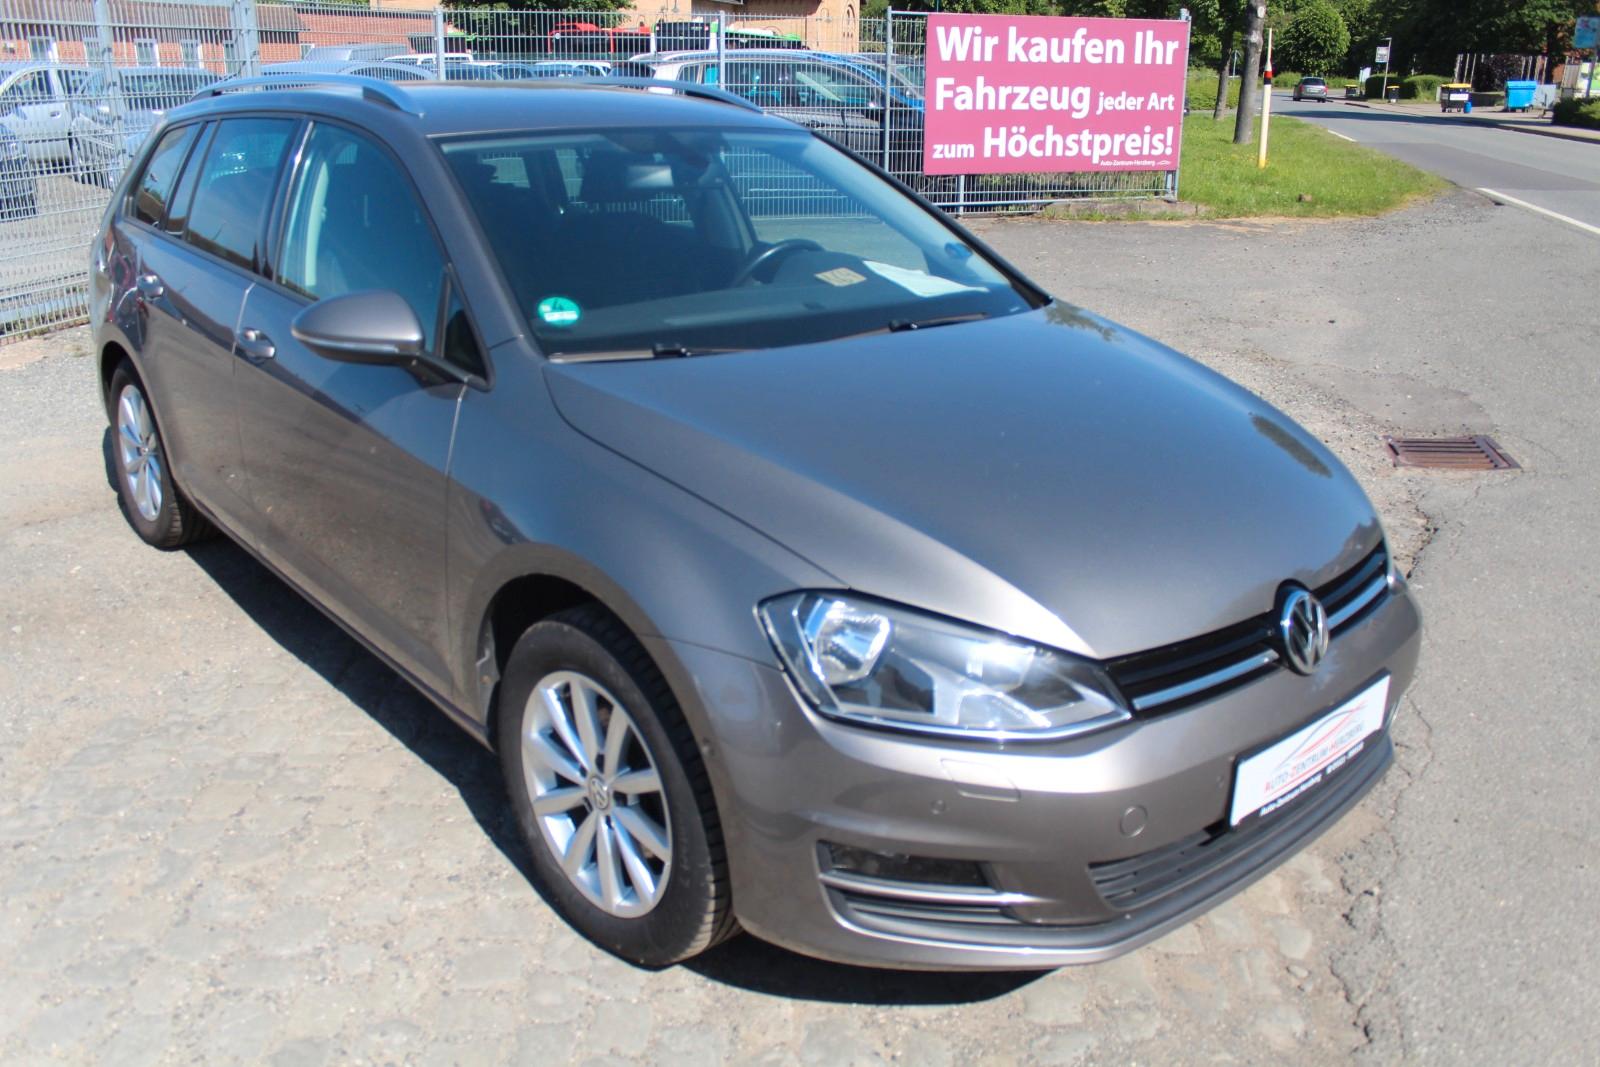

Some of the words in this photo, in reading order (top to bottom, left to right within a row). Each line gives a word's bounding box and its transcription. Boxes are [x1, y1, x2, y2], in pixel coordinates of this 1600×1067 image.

[936, 26, 998, 61] Wir
[1008, 26, 1124, 64] kaufen
[1134, 31, 1179, 64] Ihr
[936, 76, 1090, 119] Fahrzeug
[1096, 91, 1144, 115] jeder
[1147, 92, 1175, 110] Art
[933, 143, 975, 159] zum
[984, 125, 1173, 163] Höchstpreis!
